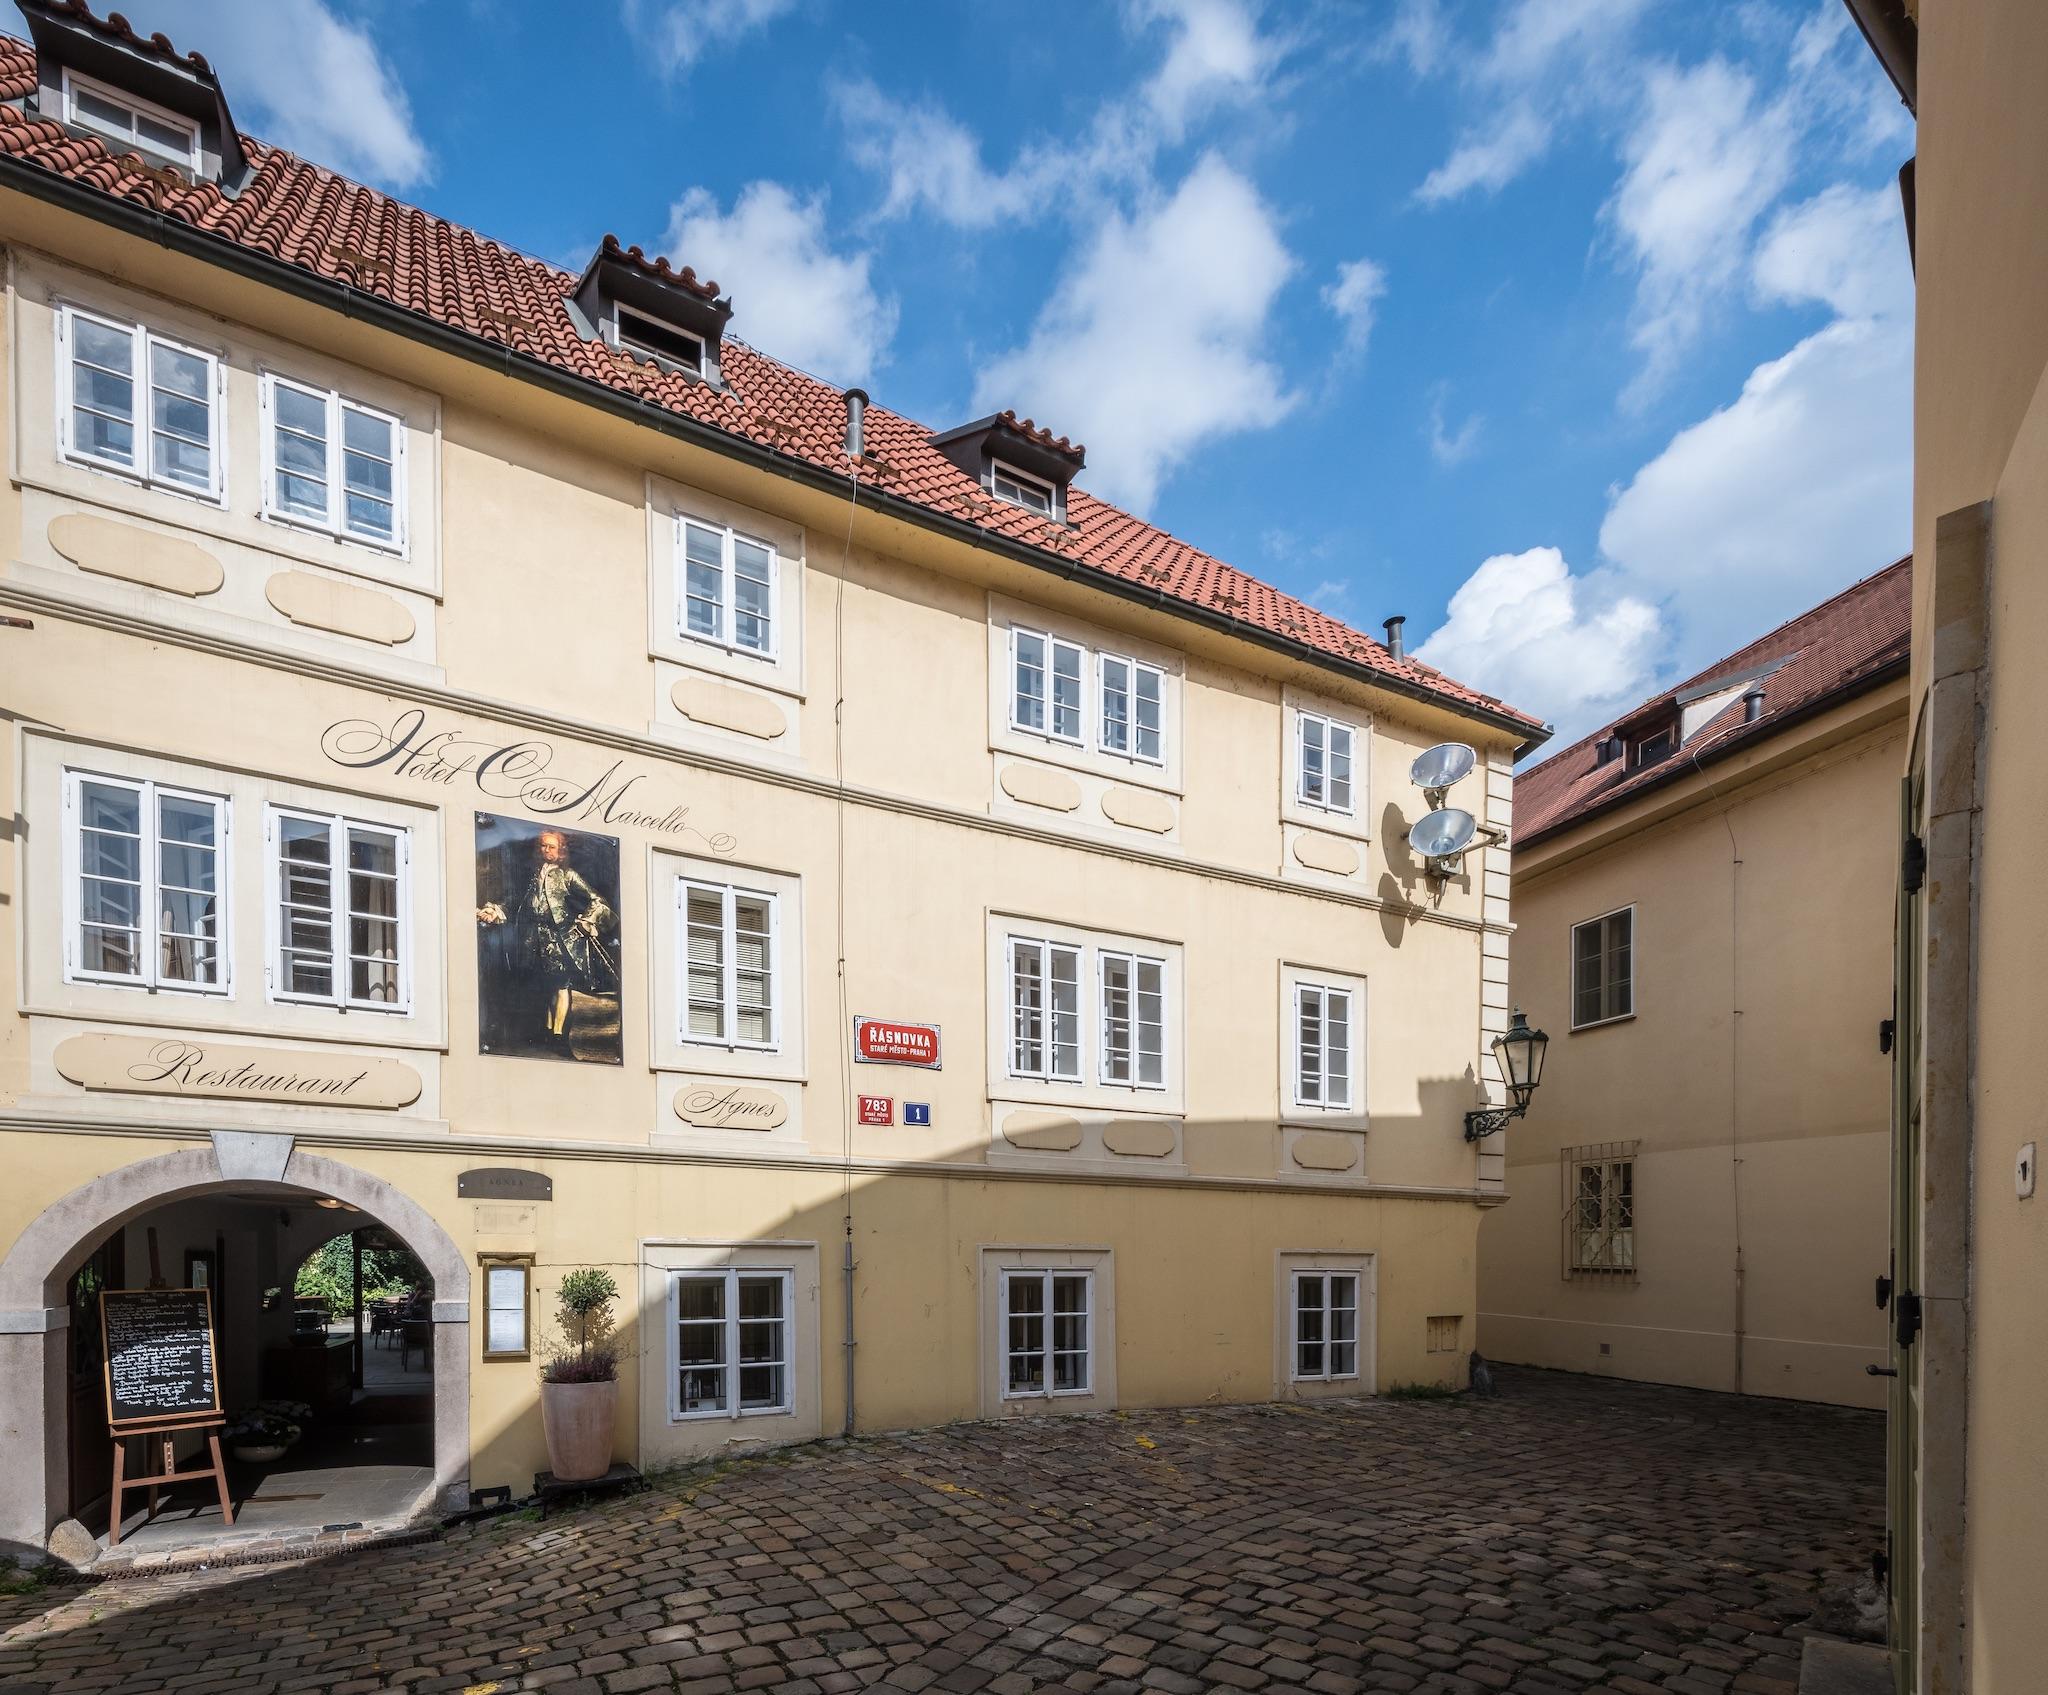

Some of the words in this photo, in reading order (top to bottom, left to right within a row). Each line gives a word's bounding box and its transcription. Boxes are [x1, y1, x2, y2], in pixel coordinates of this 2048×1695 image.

[320, 709, 476, 785] Hotel
[438, 741, 567, 805] Casa
[520, 760, 738, 857] Marcello
[869, 1026, 931, 1048] ŘÁSNOVKA
[869, 1044, 888, 1053] STARÉ
[127, 1039, 368, 1096] Restaurant
[683, 1087, 778, 1126] Agnes
[865, 1099, 887, 1112] 783
[915, 1107, 921, 1120] 1
